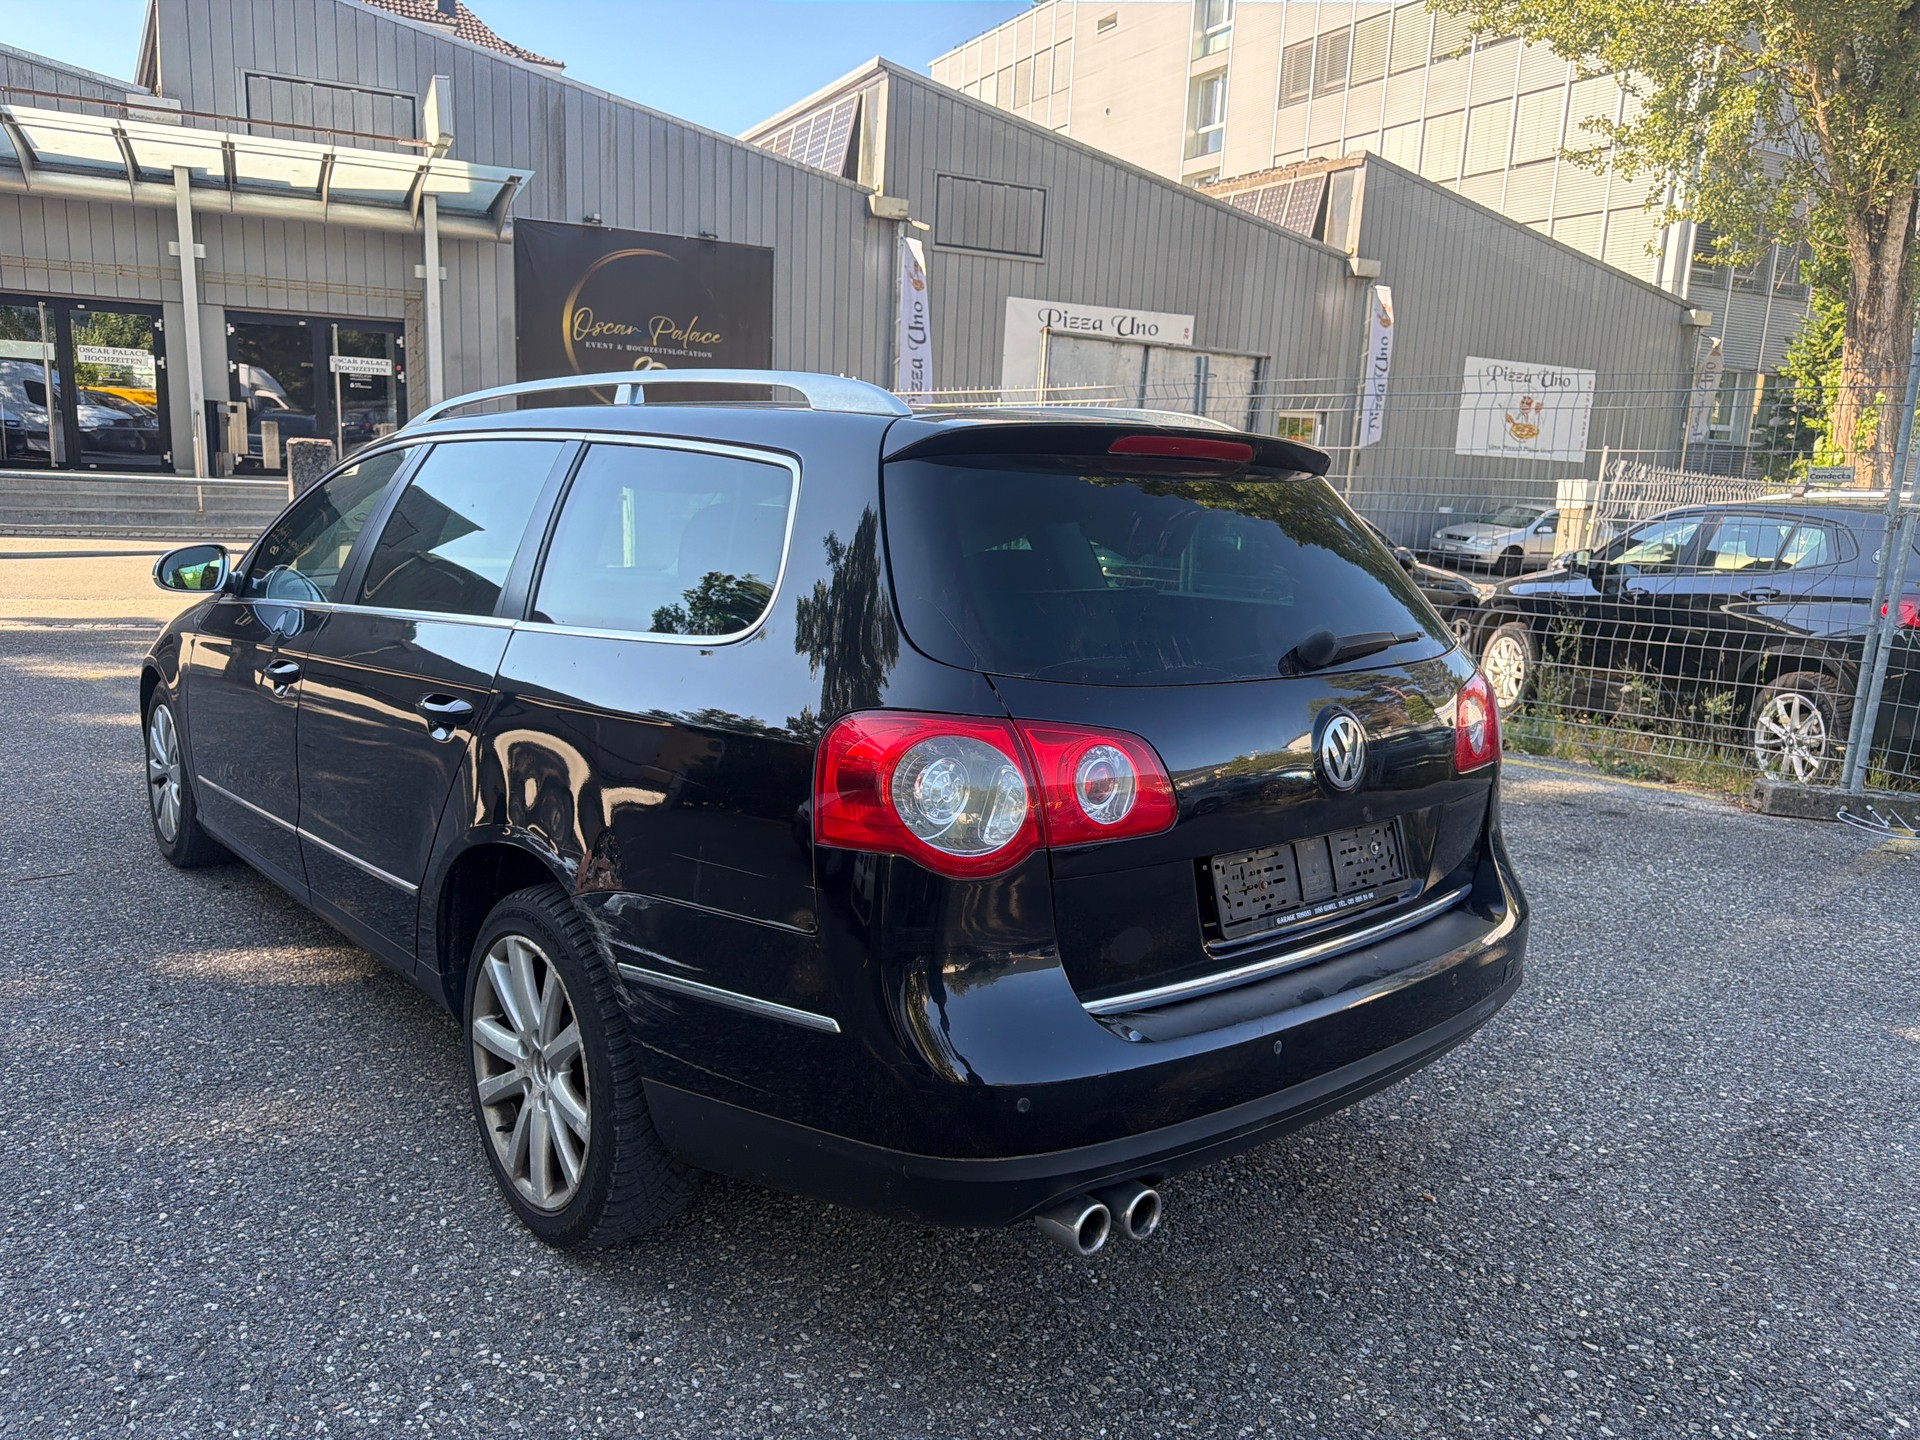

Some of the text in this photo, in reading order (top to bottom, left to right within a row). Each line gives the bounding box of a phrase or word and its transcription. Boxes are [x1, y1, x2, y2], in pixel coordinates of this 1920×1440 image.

[573, 306, 723, 349] Oscar Palace
[907, 301, 927, 350] Uno
[1037, 308, 1160, 337] Pizza Uno
[79, 346, 147, 357] OSCAR PALACE
[84, 355, 142, 365] HOCHZEITEN
[585, 341, 713, 358] EVENT & HOCHZEITSLOCATION
[1486, 364, 1571, 389] Pizza Uno
[1809, 472, 1851, 480] Condecta
